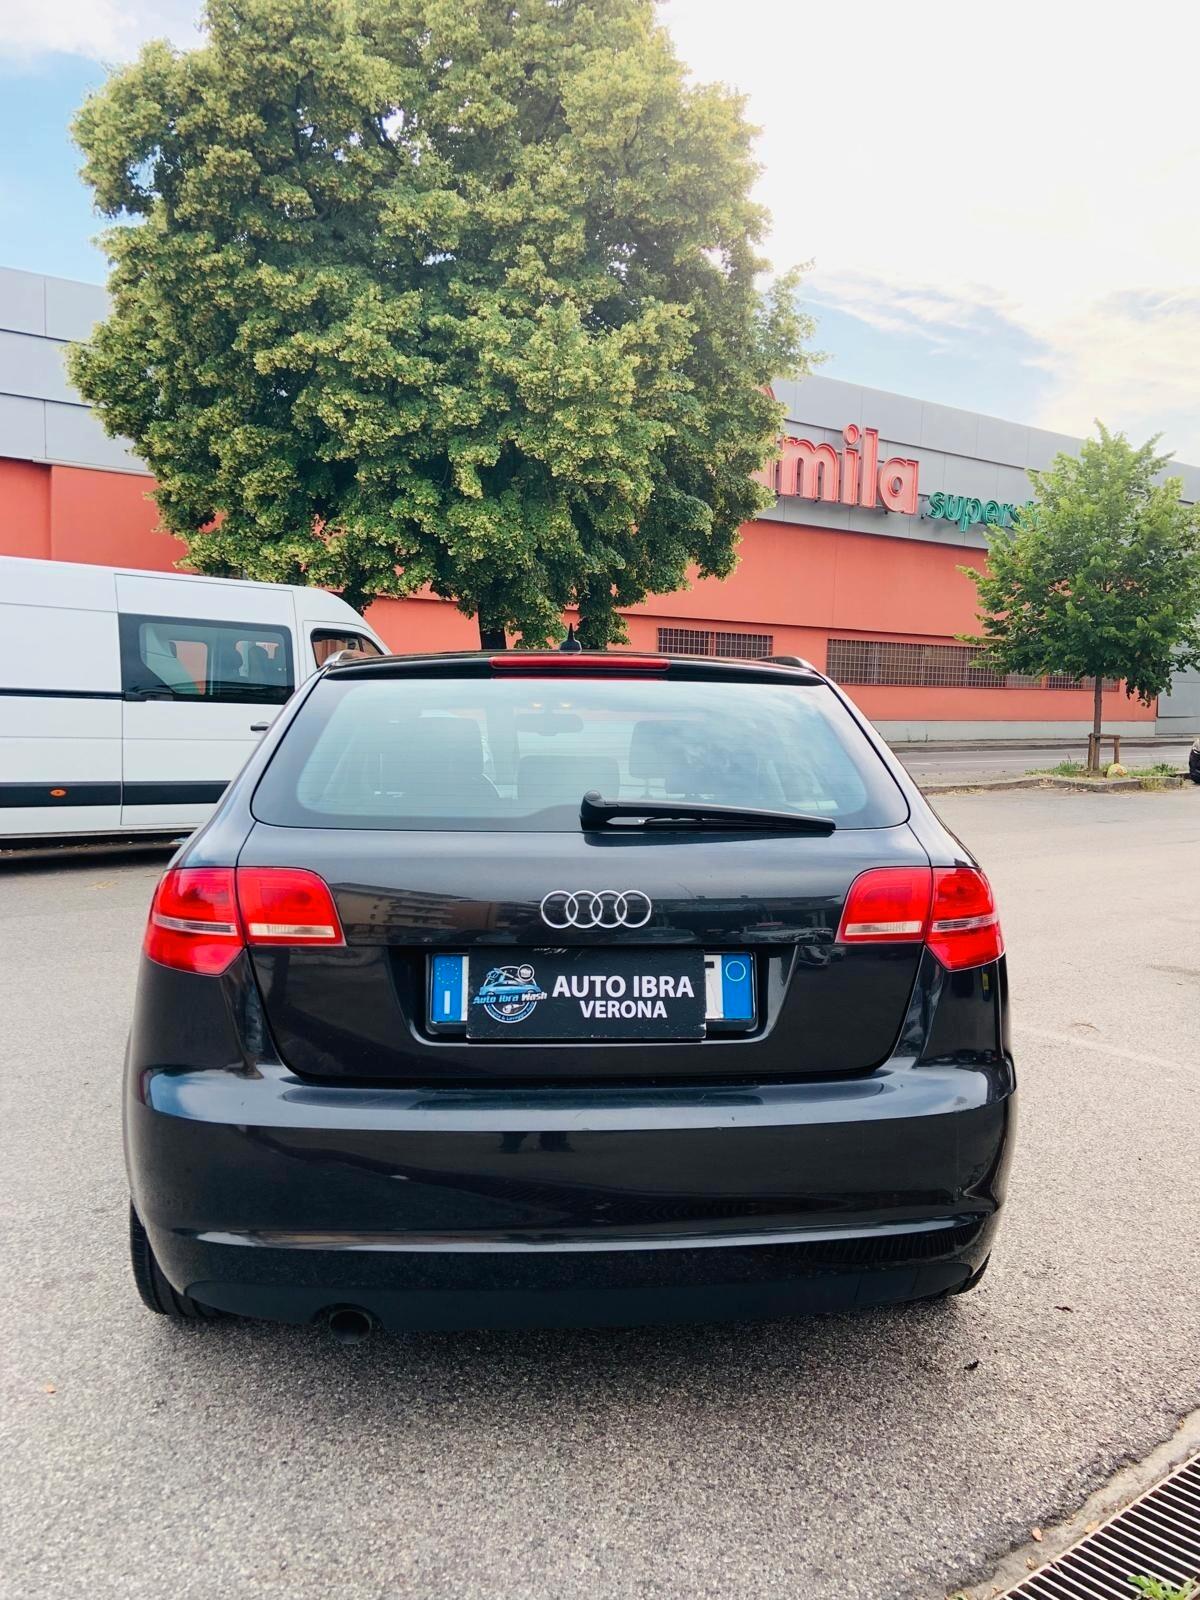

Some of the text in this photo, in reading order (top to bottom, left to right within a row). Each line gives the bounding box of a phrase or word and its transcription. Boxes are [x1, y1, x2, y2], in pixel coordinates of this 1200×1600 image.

[551, 975, 695, 998] AUTO IBRA
[472, 995, 497, 1005] Auto
[521, 991, 548, 1002] Wash
[579, 1000, 668, 1018] VERONA
